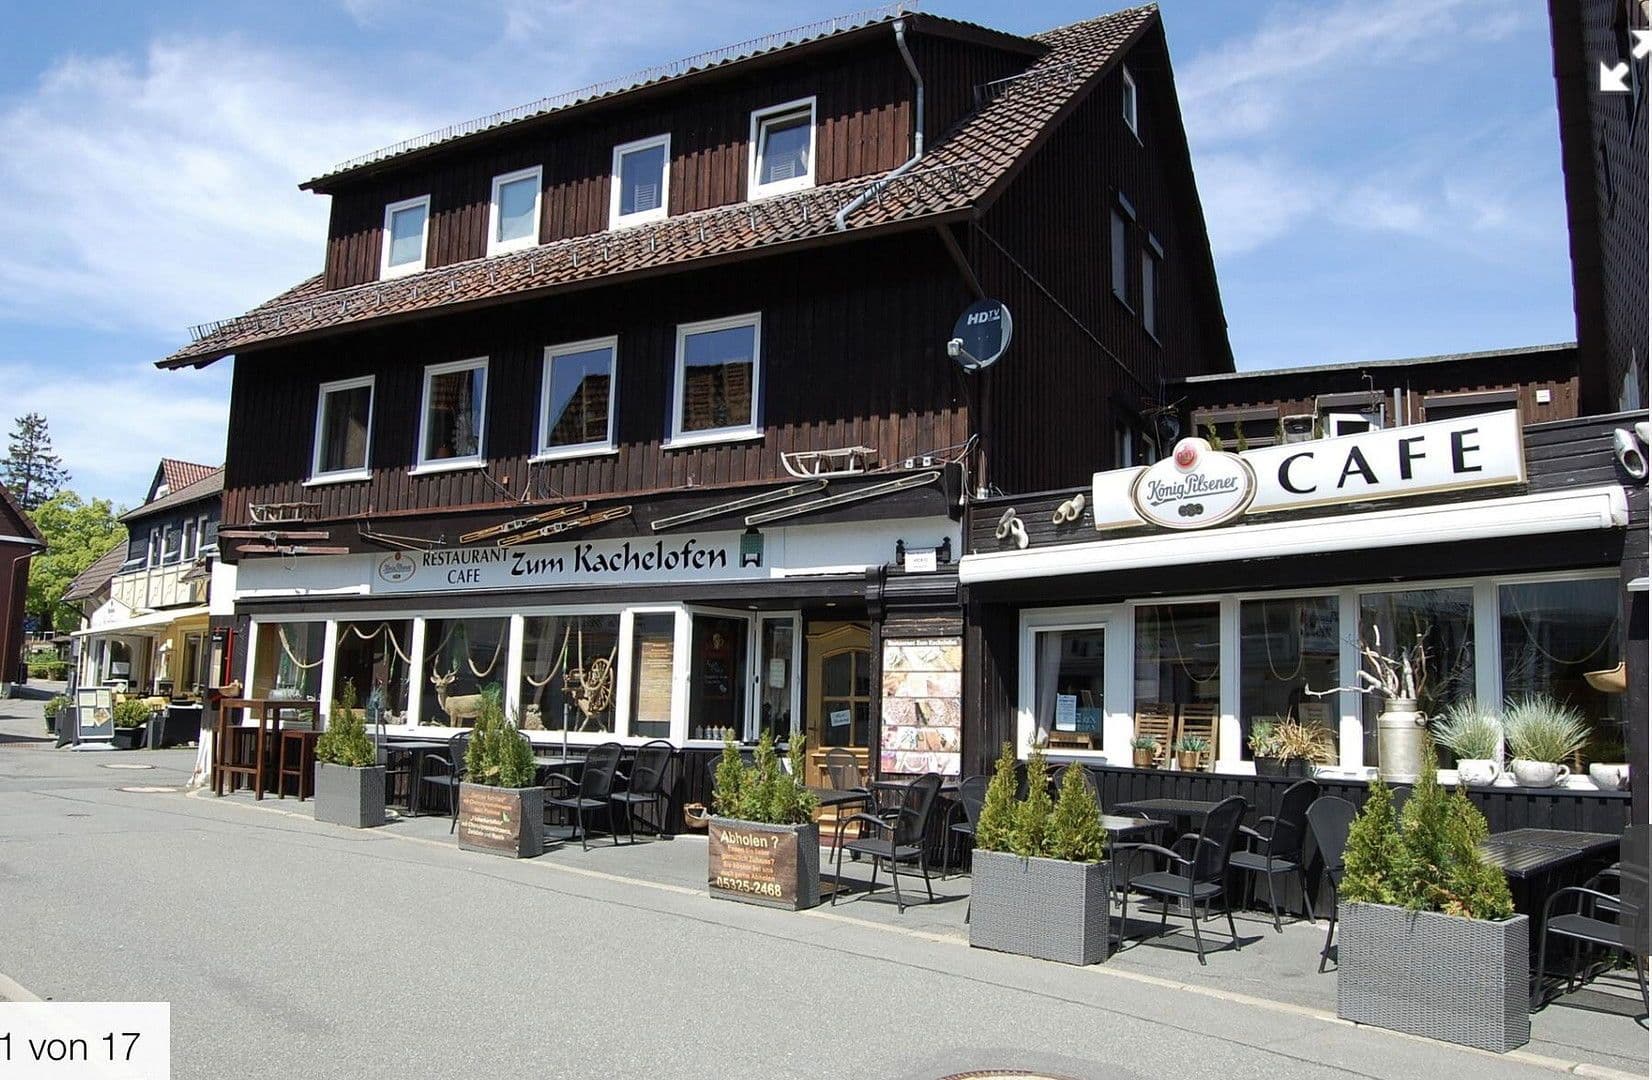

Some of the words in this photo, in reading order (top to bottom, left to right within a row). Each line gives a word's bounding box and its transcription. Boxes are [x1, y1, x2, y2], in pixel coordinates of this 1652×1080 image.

[967, 308, 1000, 325] HDTV
[1277, 428, 1482, 494] CAFE
[1147, 480, 1185, 501] König
[1184, 473, 1238, 495] Pilsener
[422, 547, 509, 566] RESTAURANT
[511, 551, 564, 576] Zum
[575, 539, 727, 573] Kachelofen
[447, 568, 480, 584] CAFE
[720, 830, 768, 848] Abholen
[771, 835, 779, 849] ?
[717, 876, 782, 896] 05325-2468
